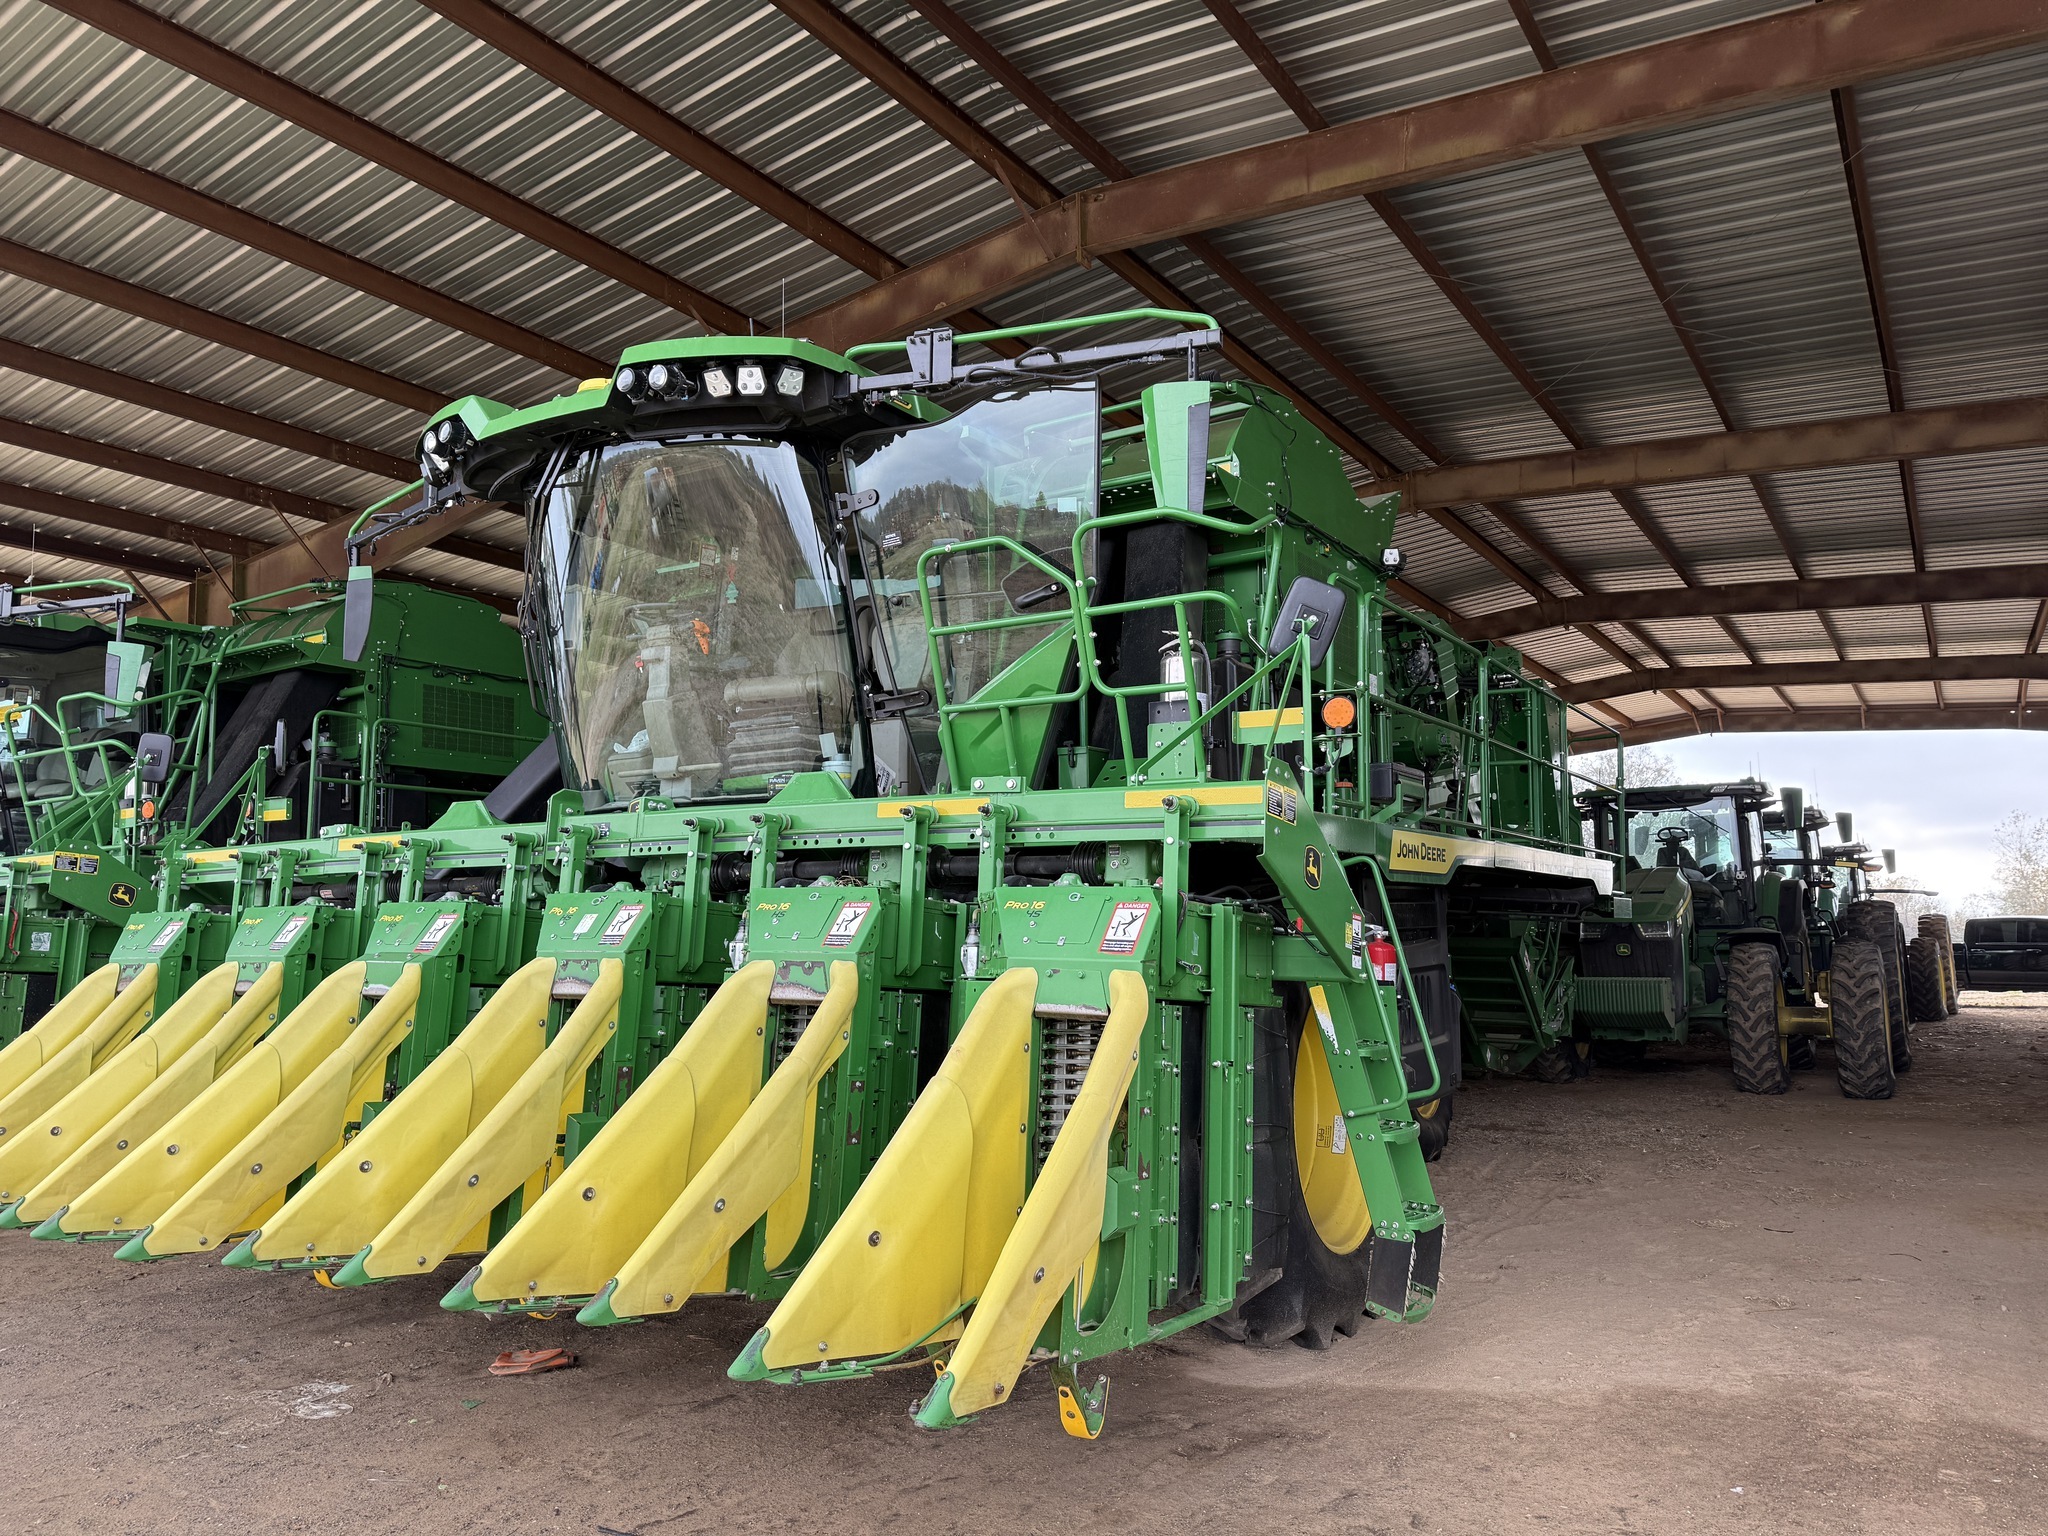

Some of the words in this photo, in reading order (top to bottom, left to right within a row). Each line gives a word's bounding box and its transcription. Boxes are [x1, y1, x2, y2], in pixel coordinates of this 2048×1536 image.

[1396, 839, 1420, 860] JOHN
[1421, 842, 1447, 862] DEERE
[778, 902, 792, 910] 16
[1031, 900, 1046, 909] 16
[566, 906, 579, 914] 16
